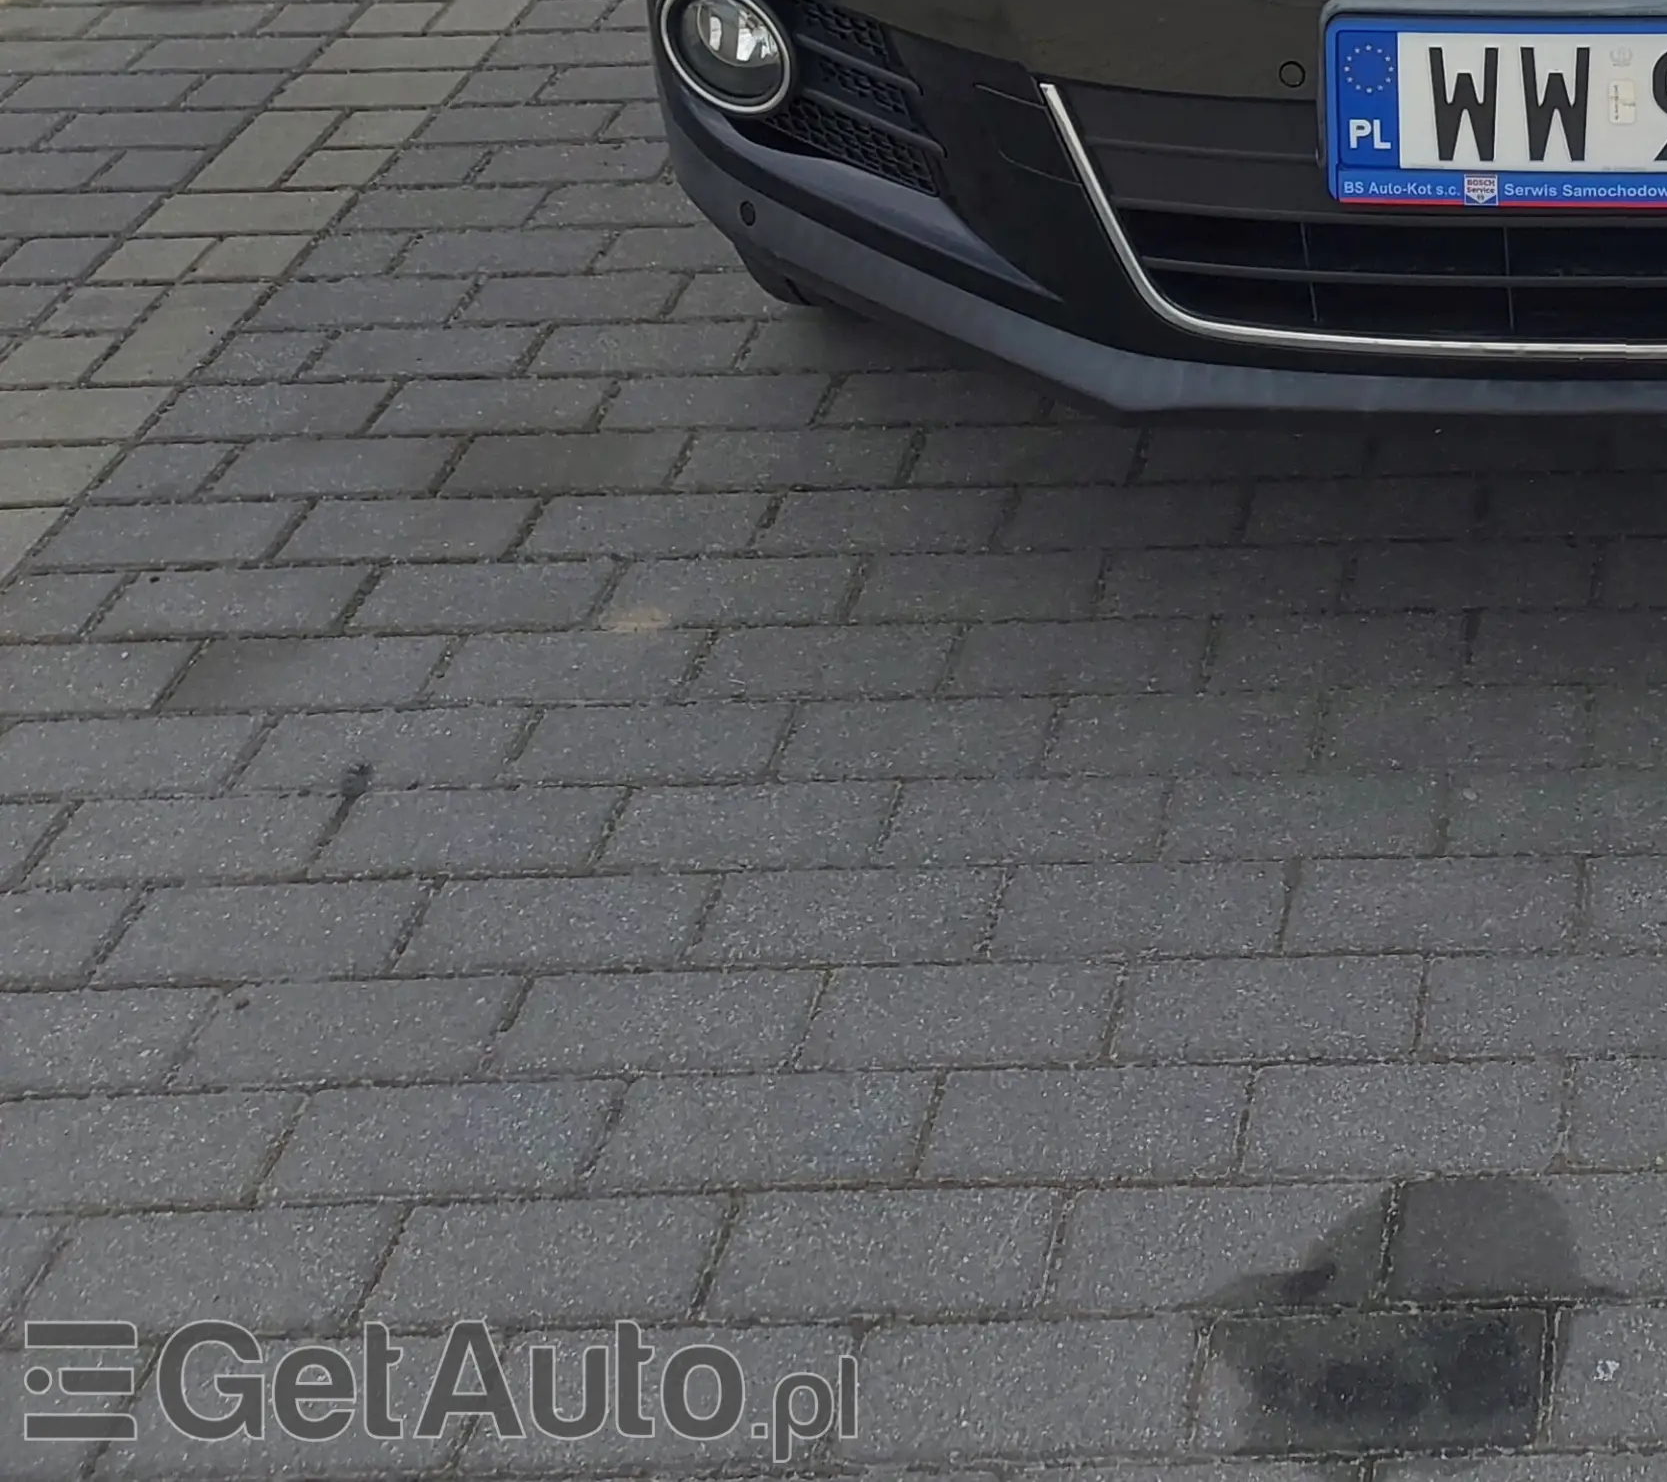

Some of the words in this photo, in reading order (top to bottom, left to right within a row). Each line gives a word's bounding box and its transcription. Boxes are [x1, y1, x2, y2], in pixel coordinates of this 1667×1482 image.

[1428, 46, 1591, 161] WW
[1350, 119, 1391, 149] PL
[1344, 181, 1364, 194] BS
[1368, 182, 1432, 196] Auto-Kot
[1436, 185, 1461, 196] s.c.
[1466, 186, 1495, 194] Service
[1504, 183, 1557, 196] Serwis
